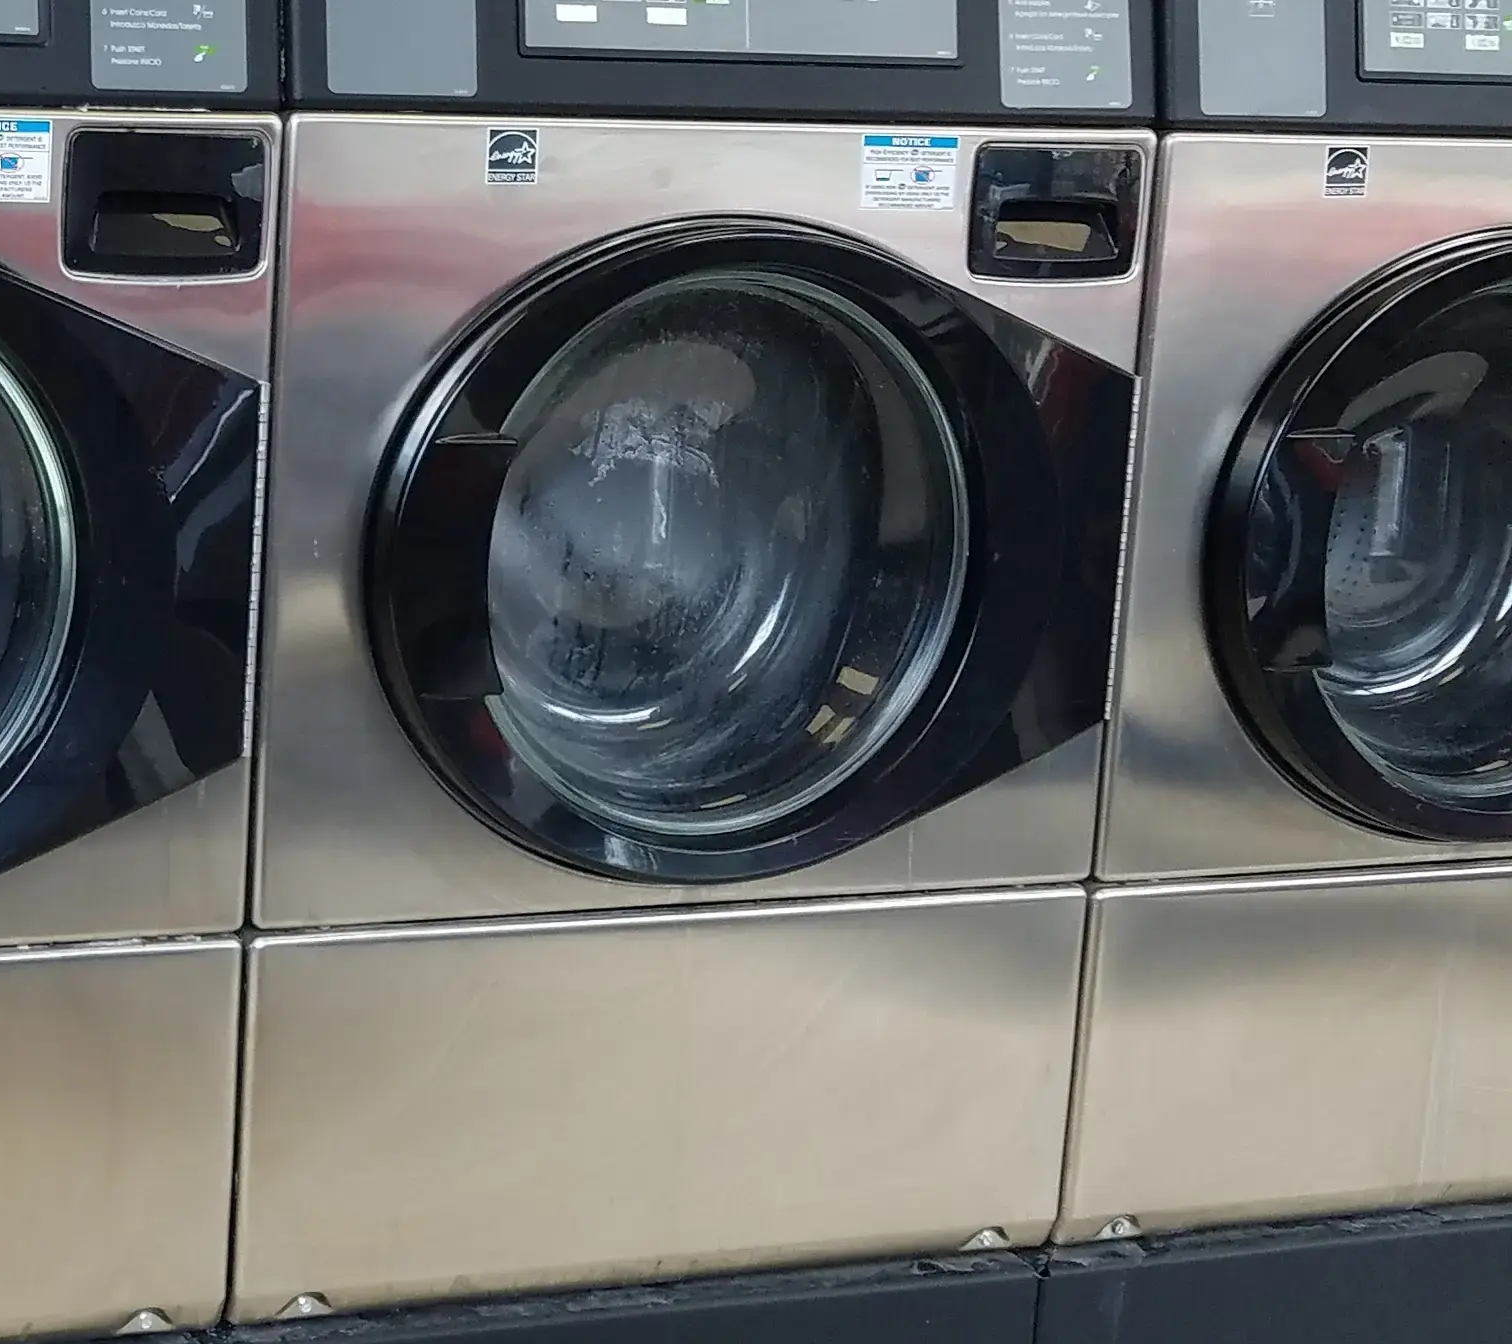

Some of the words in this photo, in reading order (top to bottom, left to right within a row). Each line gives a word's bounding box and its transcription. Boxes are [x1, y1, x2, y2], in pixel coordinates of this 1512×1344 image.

[891, 137, 931, 147] NOTICE
[488, 173, 516, 181] ENERGY
[516, 173, 536, 182] STAR
